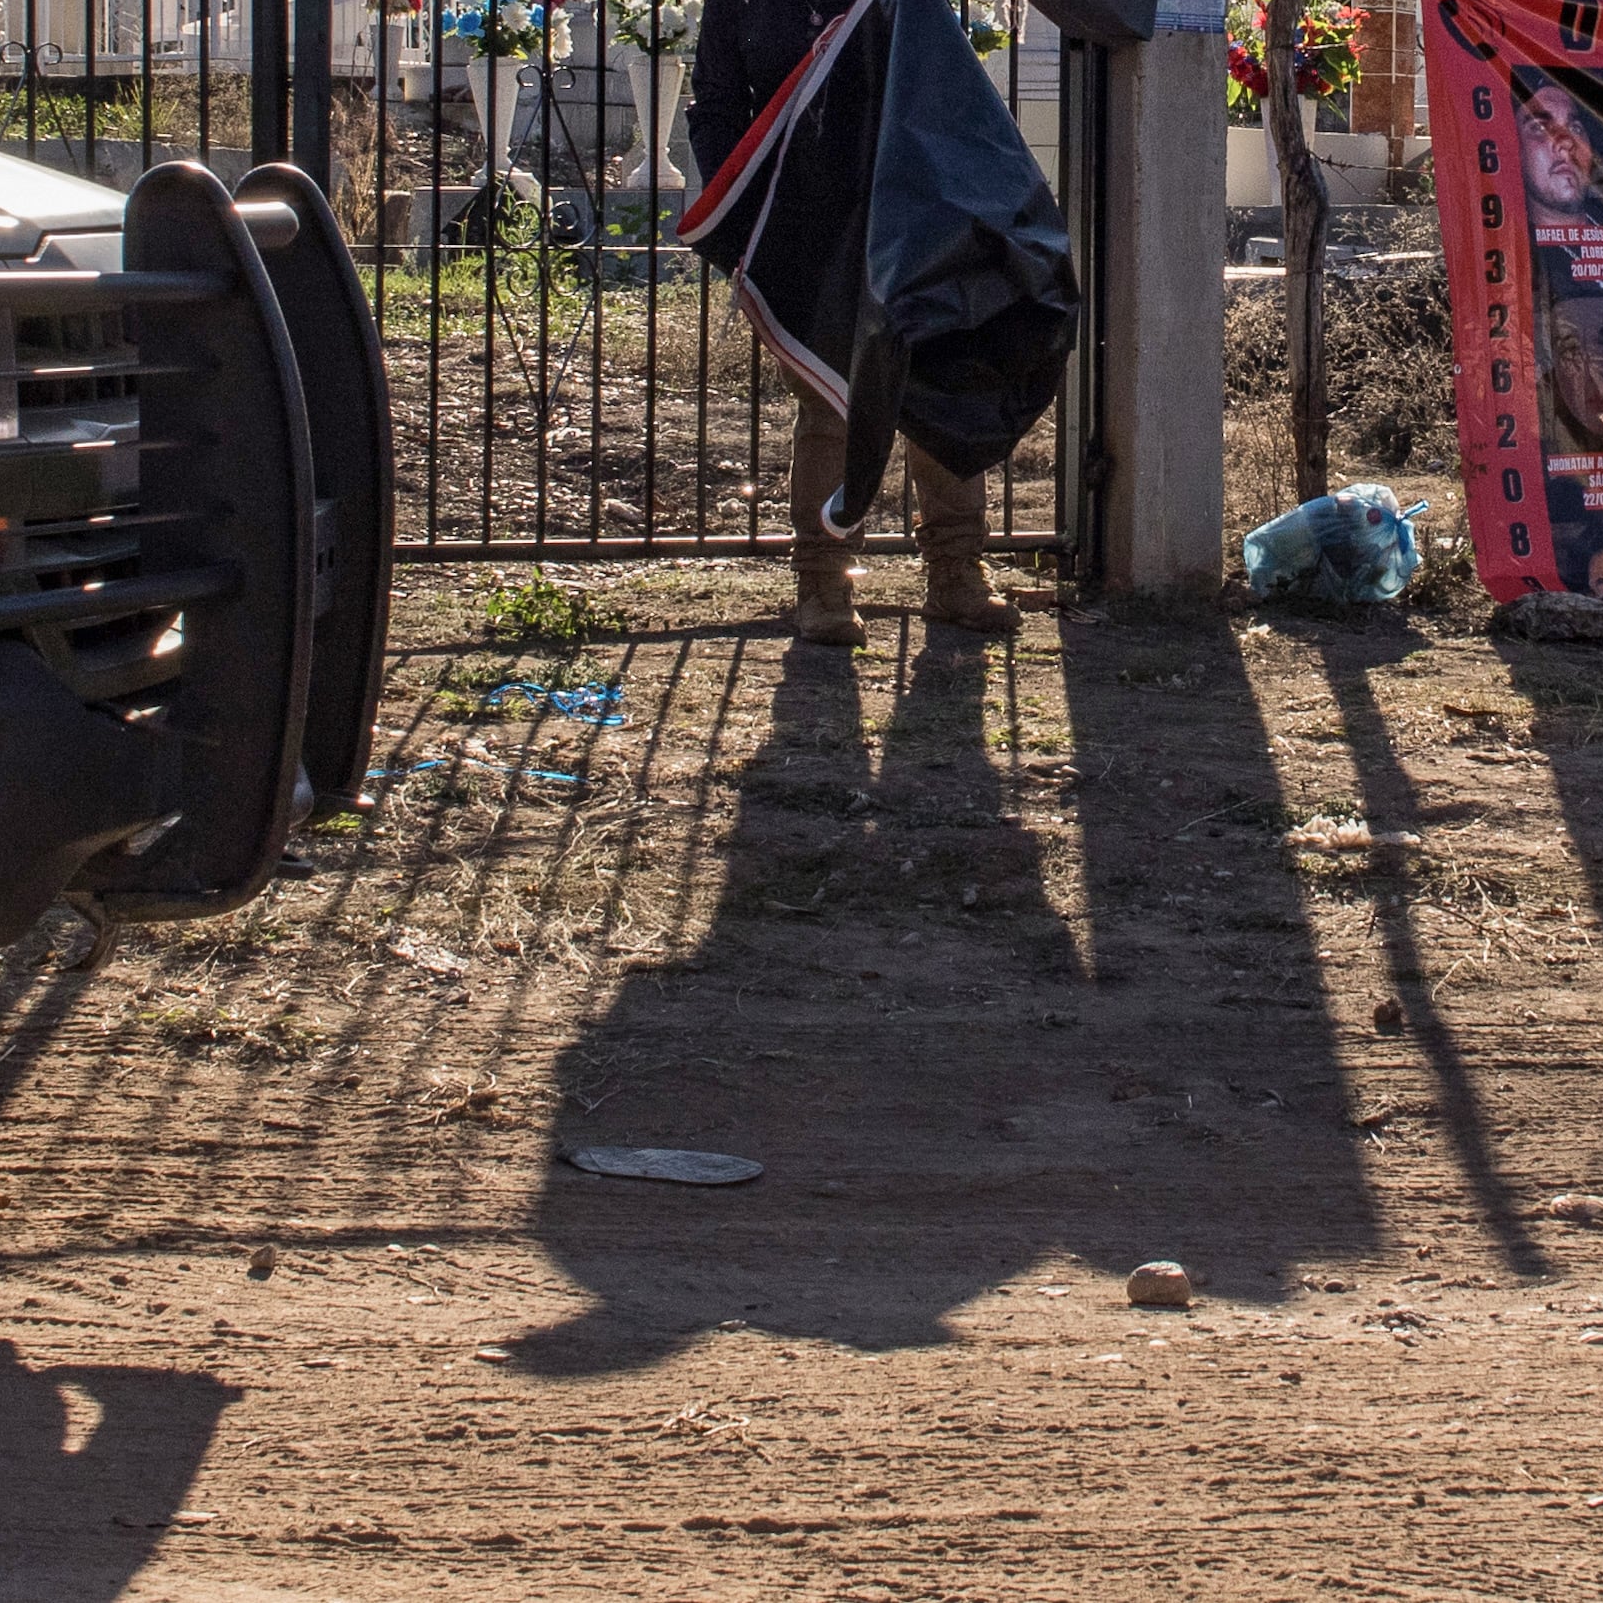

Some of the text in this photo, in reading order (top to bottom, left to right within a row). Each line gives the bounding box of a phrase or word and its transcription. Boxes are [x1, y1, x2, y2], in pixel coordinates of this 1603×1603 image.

[1536, 229, 1566, 242] RAFAEL
[1568, 229, 1580, 241] DE
[1548, 458, 1595, 472] JHONATAN
